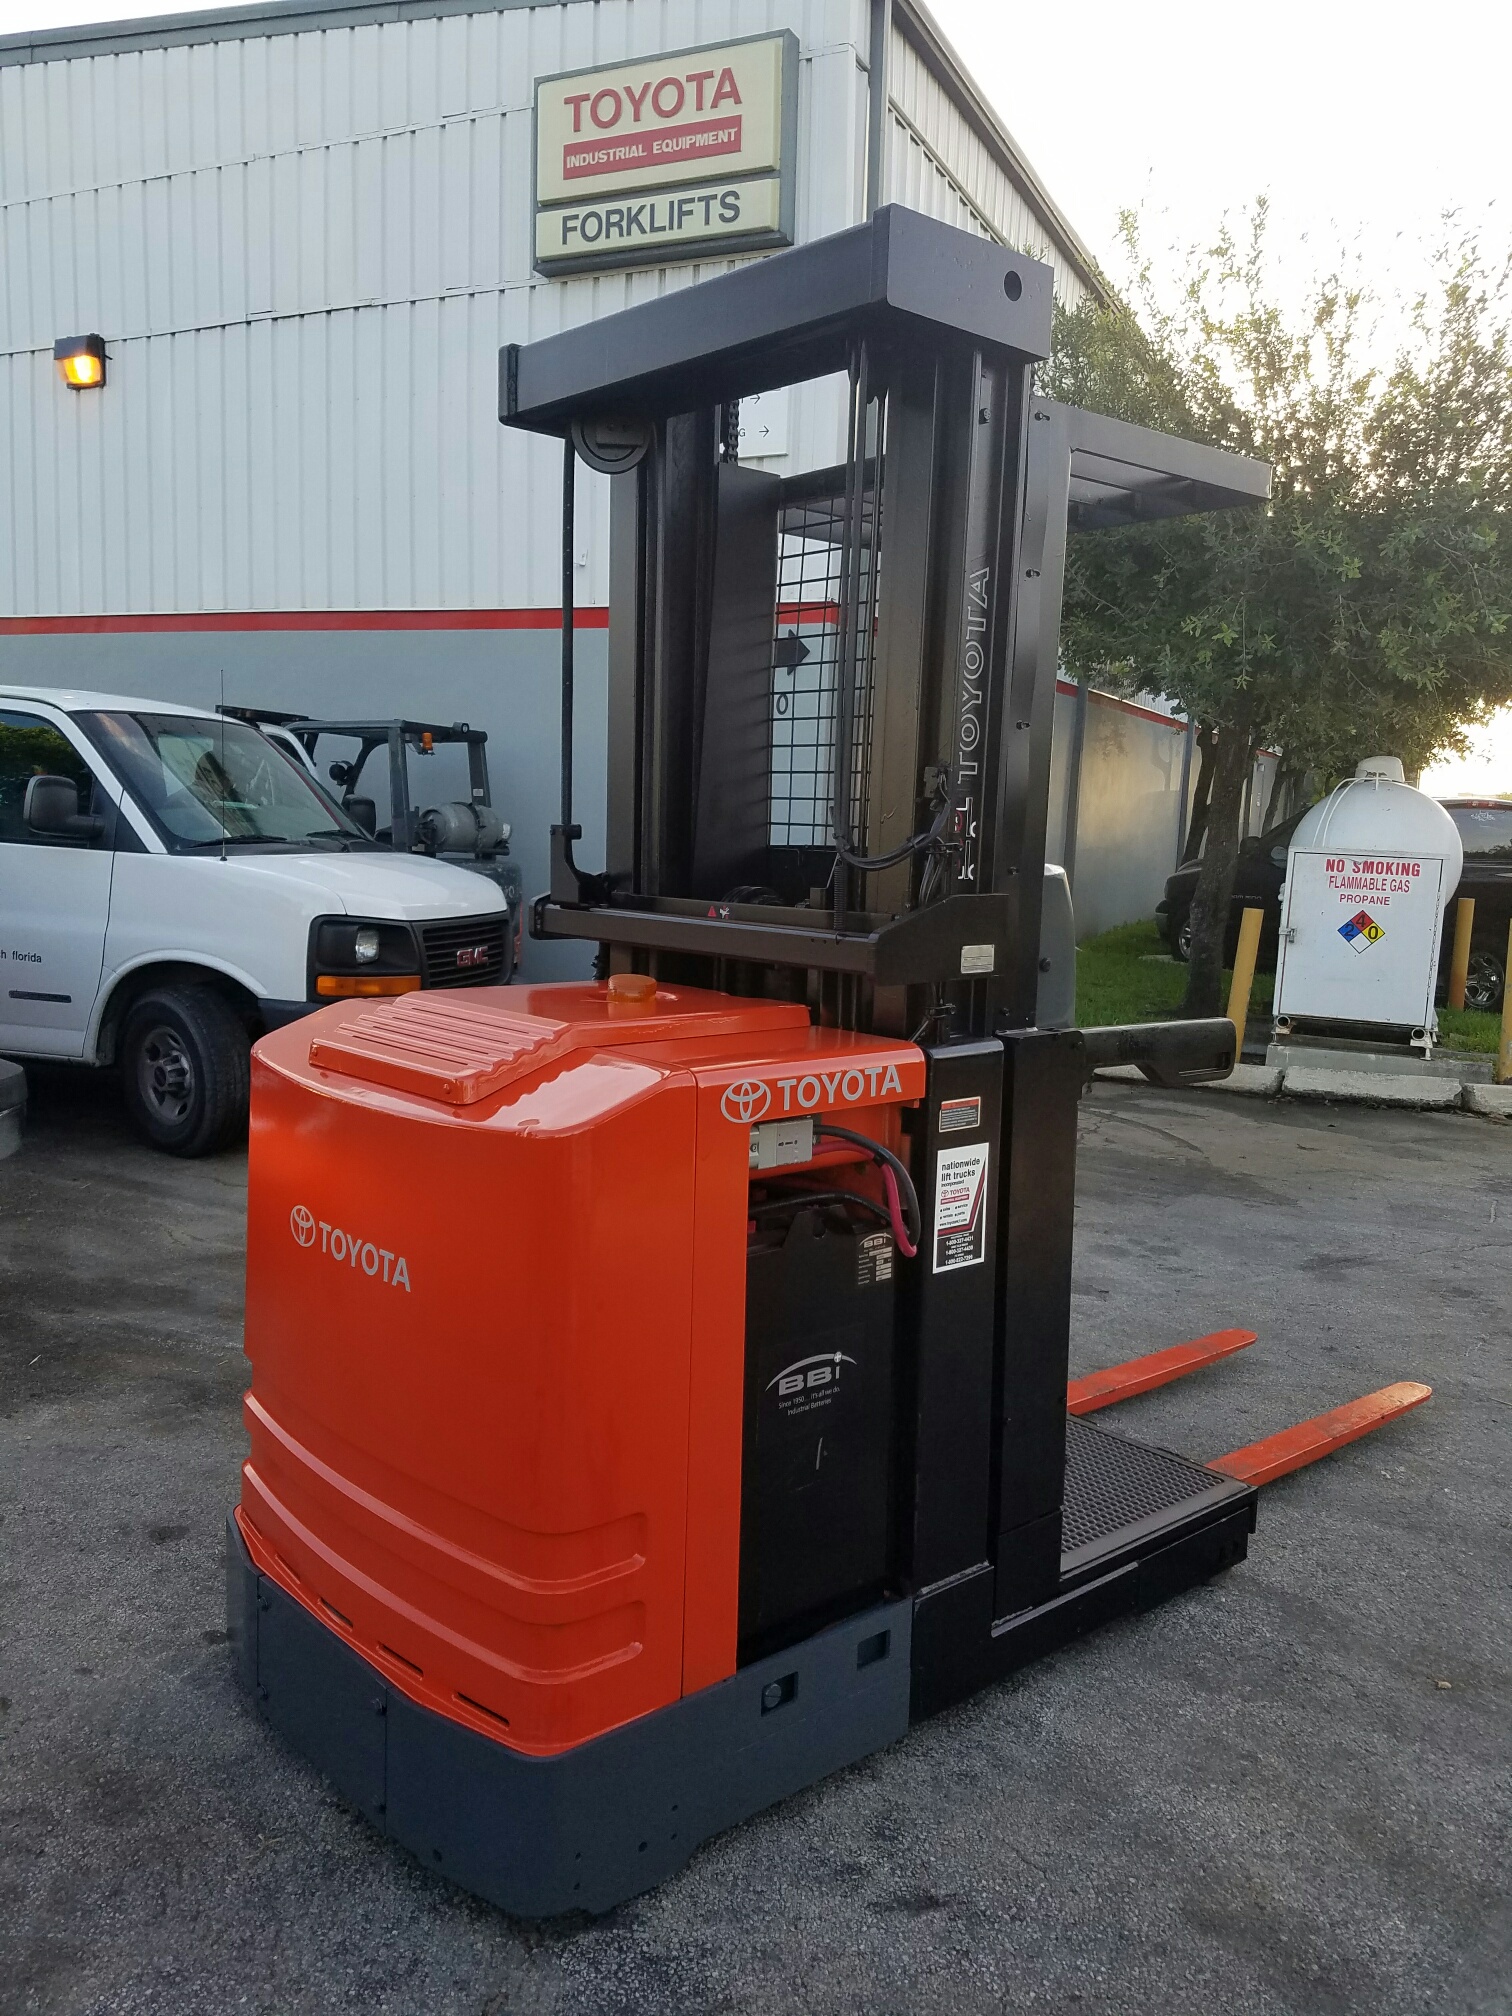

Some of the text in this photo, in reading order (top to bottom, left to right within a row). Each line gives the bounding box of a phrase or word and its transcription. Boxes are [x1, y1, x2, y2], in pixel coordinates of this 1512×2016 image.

[563, 67, 743, 132] TOYOTA
[566, 128, 738, 169] INDUSTRIAL EQUIPMENT
[561, 190, 741, 245] FORKLIFTS
[957, 566, 990, 785] TOYOTA
[1325, 858, 1421, 877] NO SMOKING
[1328, 875, 1411, 893] FLAMMABLE GAS
[1339, 893, 1391, 906] PROPANE
[1355, 914, 1367, 928] 4
[1344, 923, 1379, 940] 2 0
[12, 950, 42, 963] florida
[457, 945, 489, 968] GMC
[777, 1064, 902, 1111] TOYOTA
[941, 1157, 981, 1171] nationwide
[941, 1168, 976, 1182] lift trucks
[950, 1187, 970, 1196] TOYOTA
[319, 1220, 411, 1293] TOYOTA
[778, 1400, 792, 1410] Since
[787, 1397, 832, 1416] Industrial Batteries
